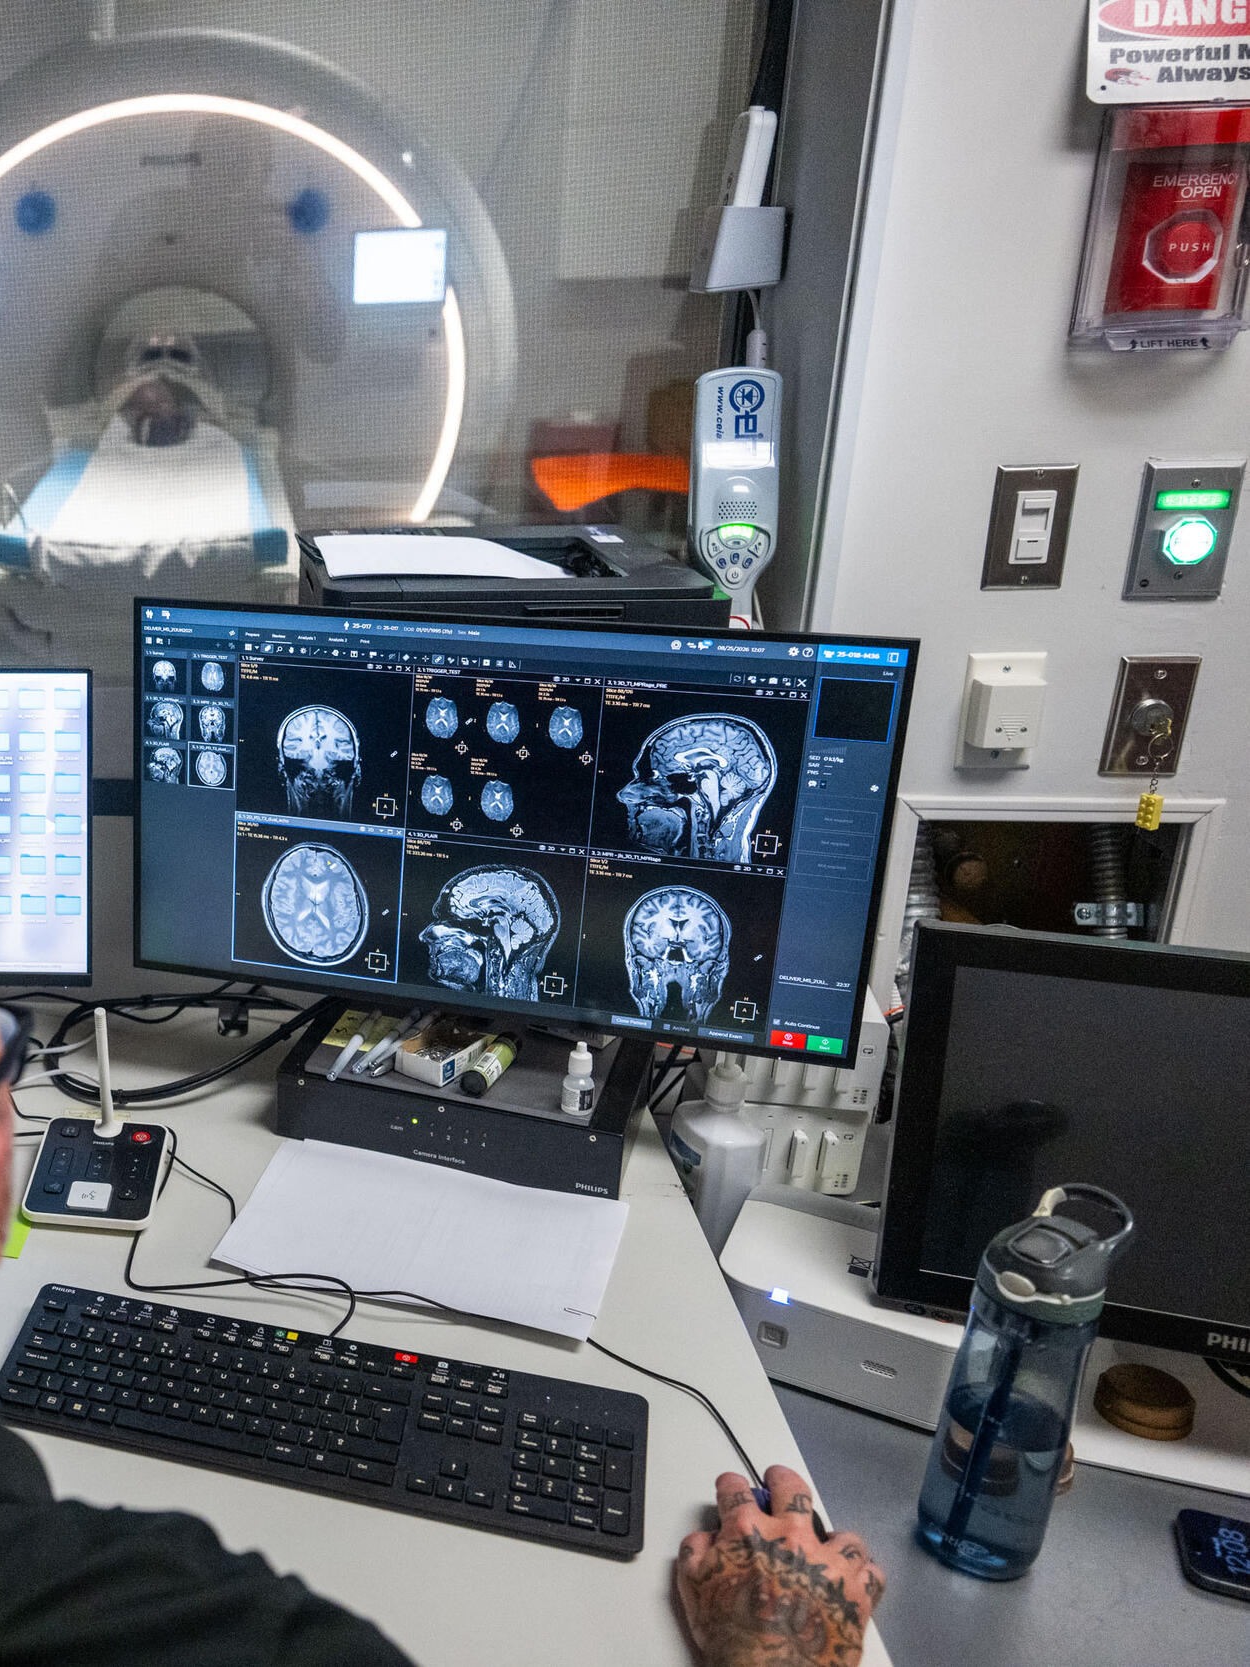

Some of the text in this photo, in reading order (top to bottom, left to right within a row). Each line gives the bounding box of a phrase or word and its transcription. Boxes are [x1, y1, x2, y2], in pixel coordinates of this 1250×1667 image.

[1110, 44, 1230, 64] Powerful
[1152, 173, 1240, 187] EMERGENCY
[1180, 186, 1222, 198] OPEN
[1169, 242, 1210, 252] PUSH
[1140, 338, 1198, 348] LIFT HERE
[709, 1030, 728, 1039] Append
[413, 1149, 437, 1159] Camera
[575, 1182, 608, 1195] PHILIPS
[52, 1285, 76, 1294] PHILIPS
[1207, 1332, 1250, 1353] PHI
